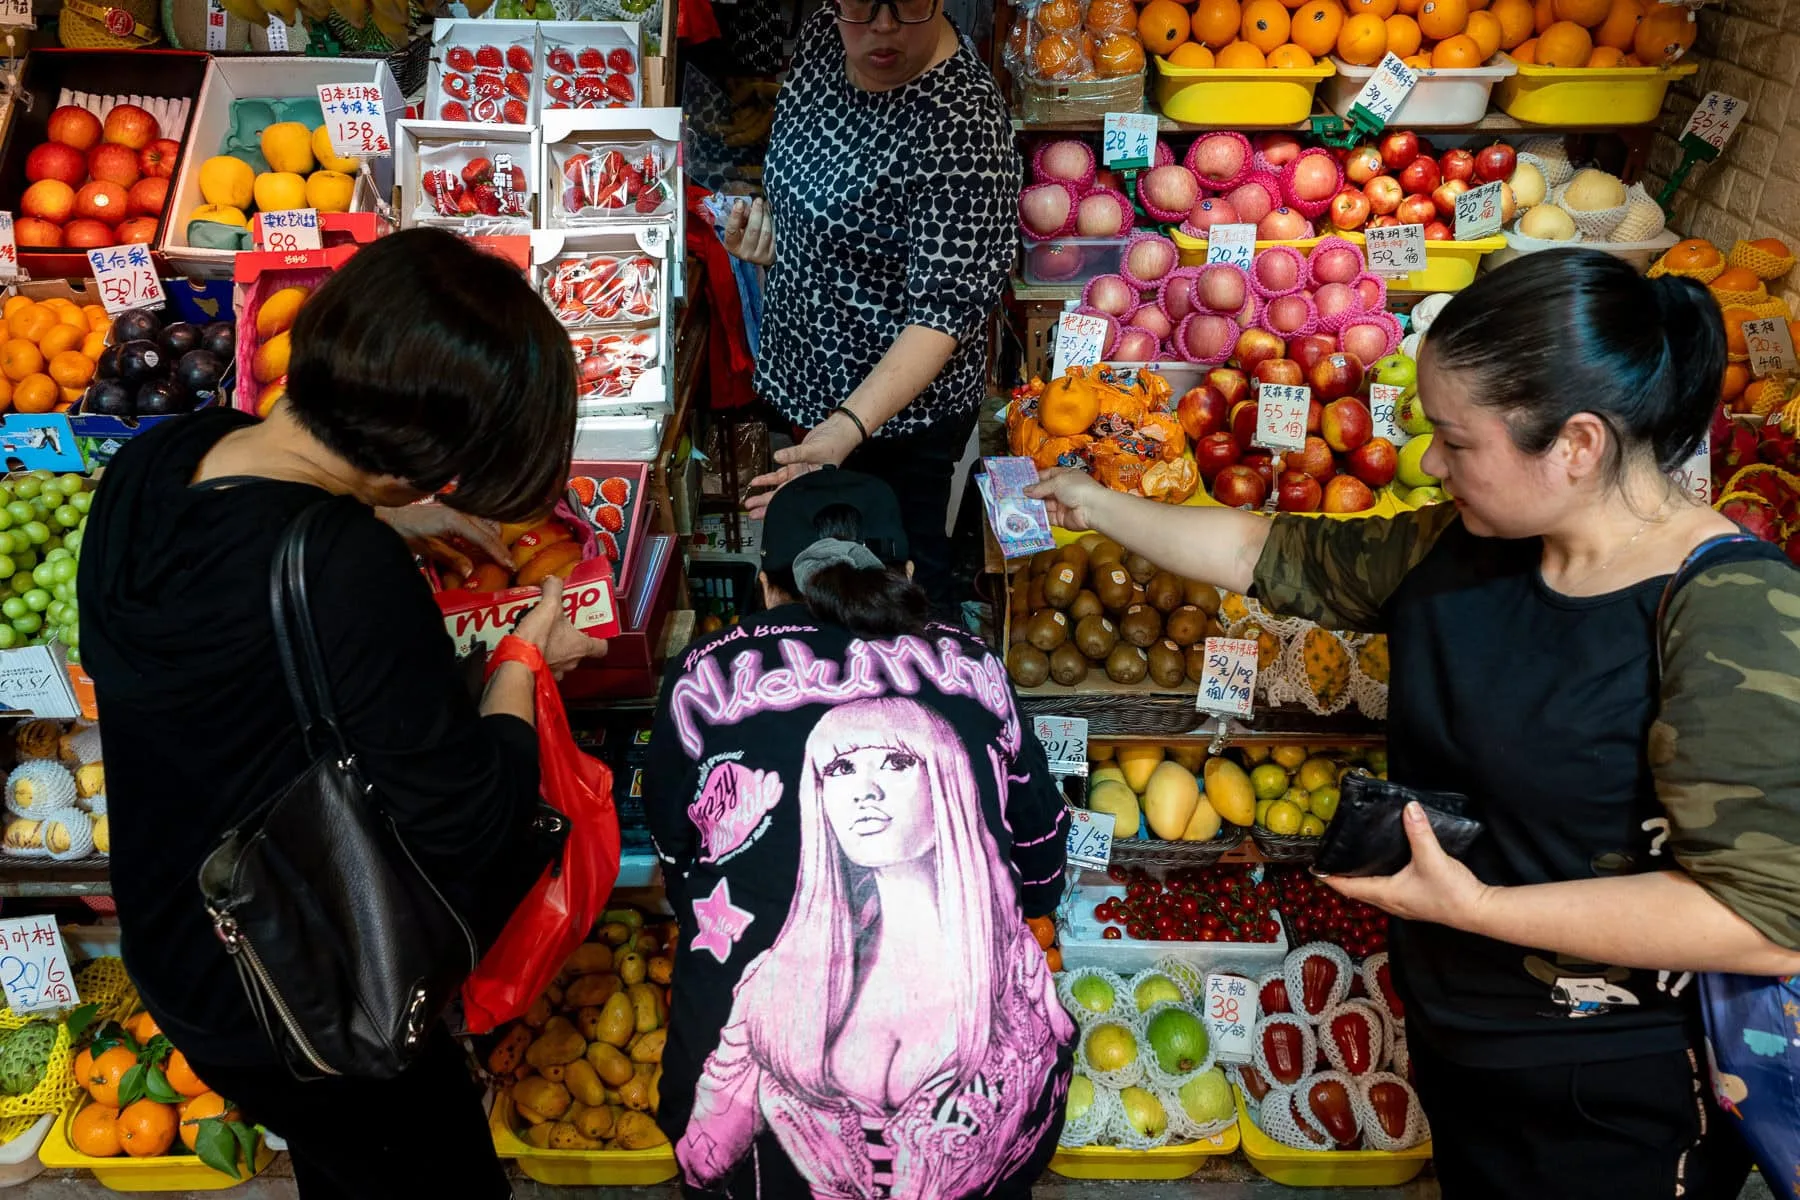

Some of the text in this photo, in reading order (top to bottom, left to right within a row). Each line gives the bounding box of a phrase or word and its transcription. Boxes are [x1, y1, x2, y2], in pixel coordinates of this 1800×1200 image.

[338, 121, 374, 142] 138
[1105, 129, 1149, 151] 28 4
[1459, 196, 1492, 219] 20 6
[1210, 245, 1249, 264] 20 4
[1372, 249, 1393, 264] 50
[1264, 403, 1303, 421] 55 4
[456, 587, 601, 637] mago
[683, 625, 750, 671] Proud
[1209, 654, 1229, 668] 50
[670, 637, 885, 760] Nicki
[1211, 994, 1240, 1023] 38
